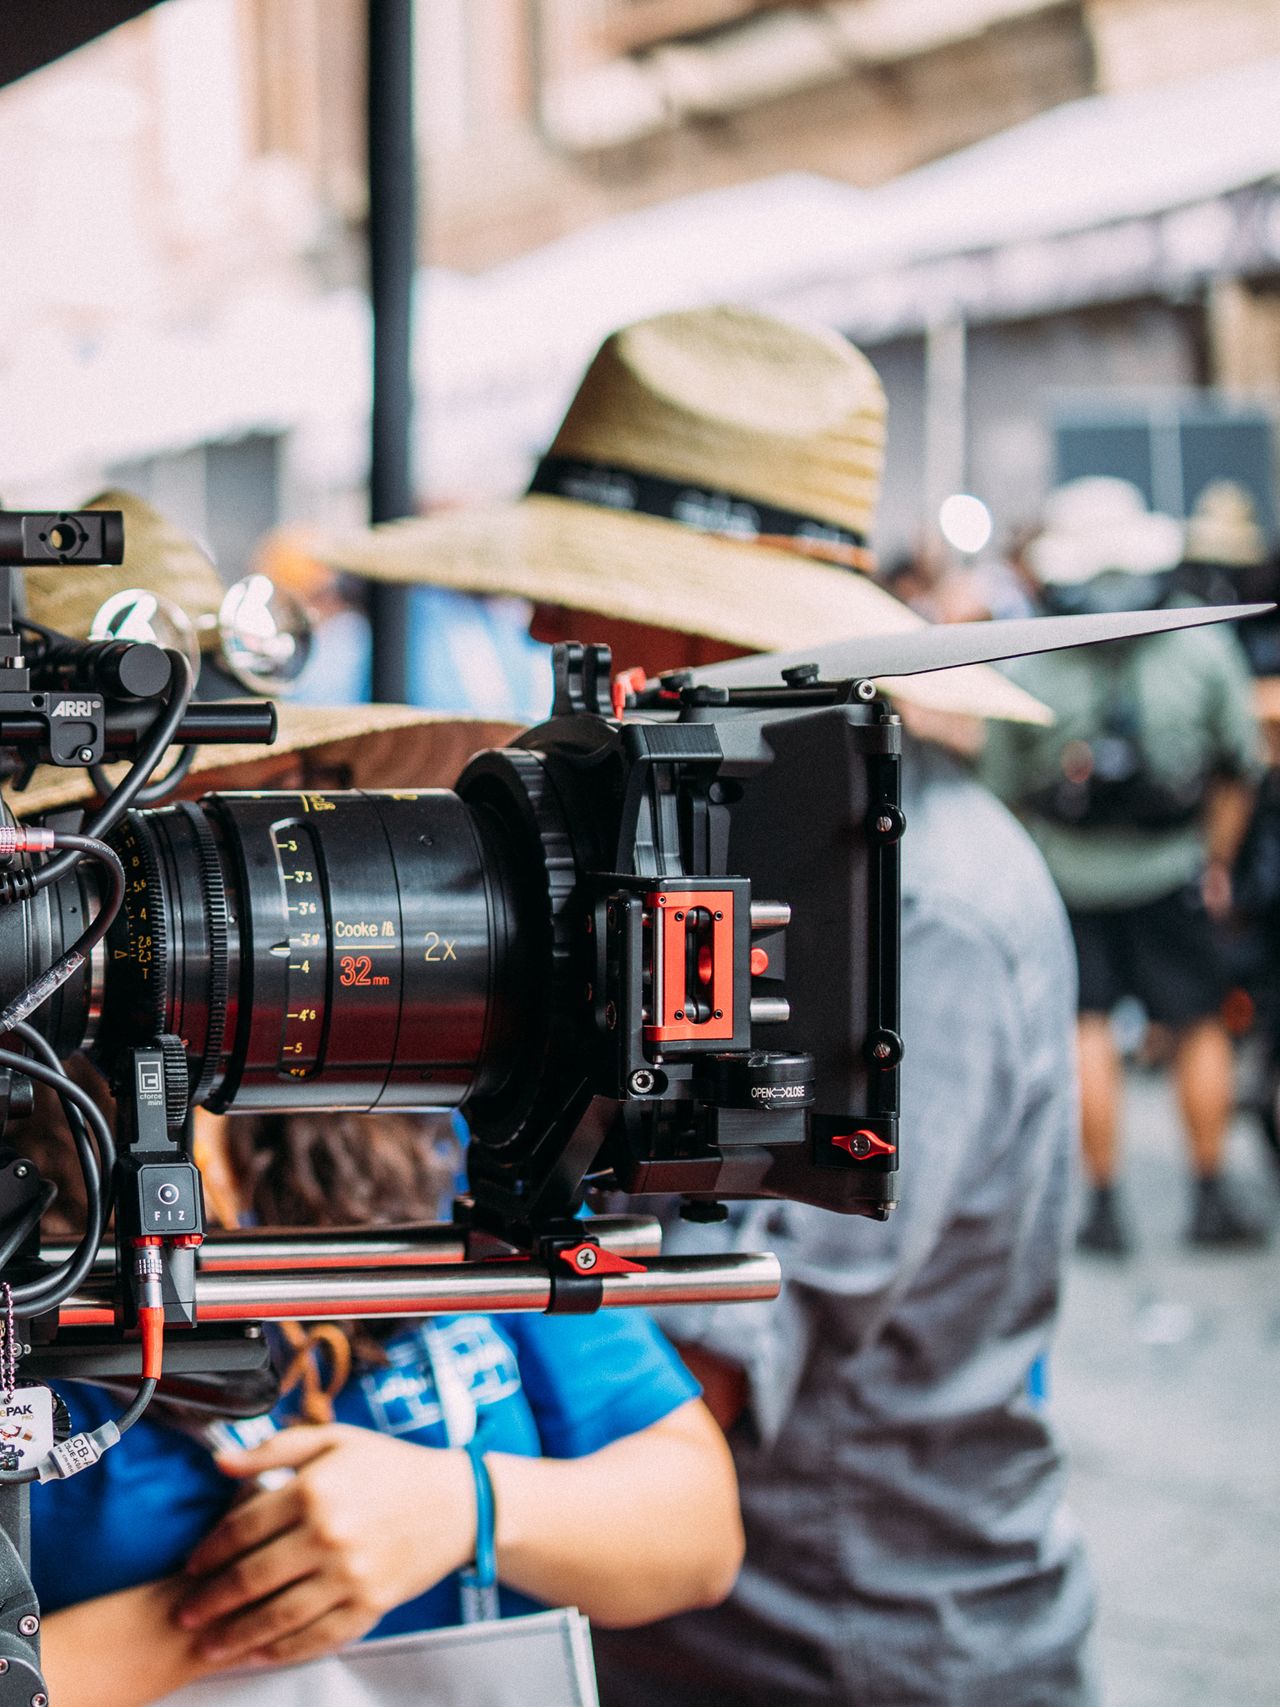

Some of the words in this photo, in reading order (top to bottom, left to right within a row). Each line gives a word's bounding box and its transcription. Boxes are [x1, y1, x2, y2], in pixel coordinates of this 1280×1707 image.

[51, 700, 91, 717] ARRI
[288, 840, 298, 851] 3
[132, 856, 140, 867] 8
[133, 879, 147, 892] 5.6
[140, 908, 147, 920] 4
[335, 921, 378, 937] Cooke
[138, 935, 152, 948] 2.8
[424, 931, 457, 961] 2x
[301, 960, 310, 974] 4
[294, 1042, 303, 1053] 5
[751, 1087, 772, 1098] OPEN
[785, 1086, 805, 1097] CLOSE
